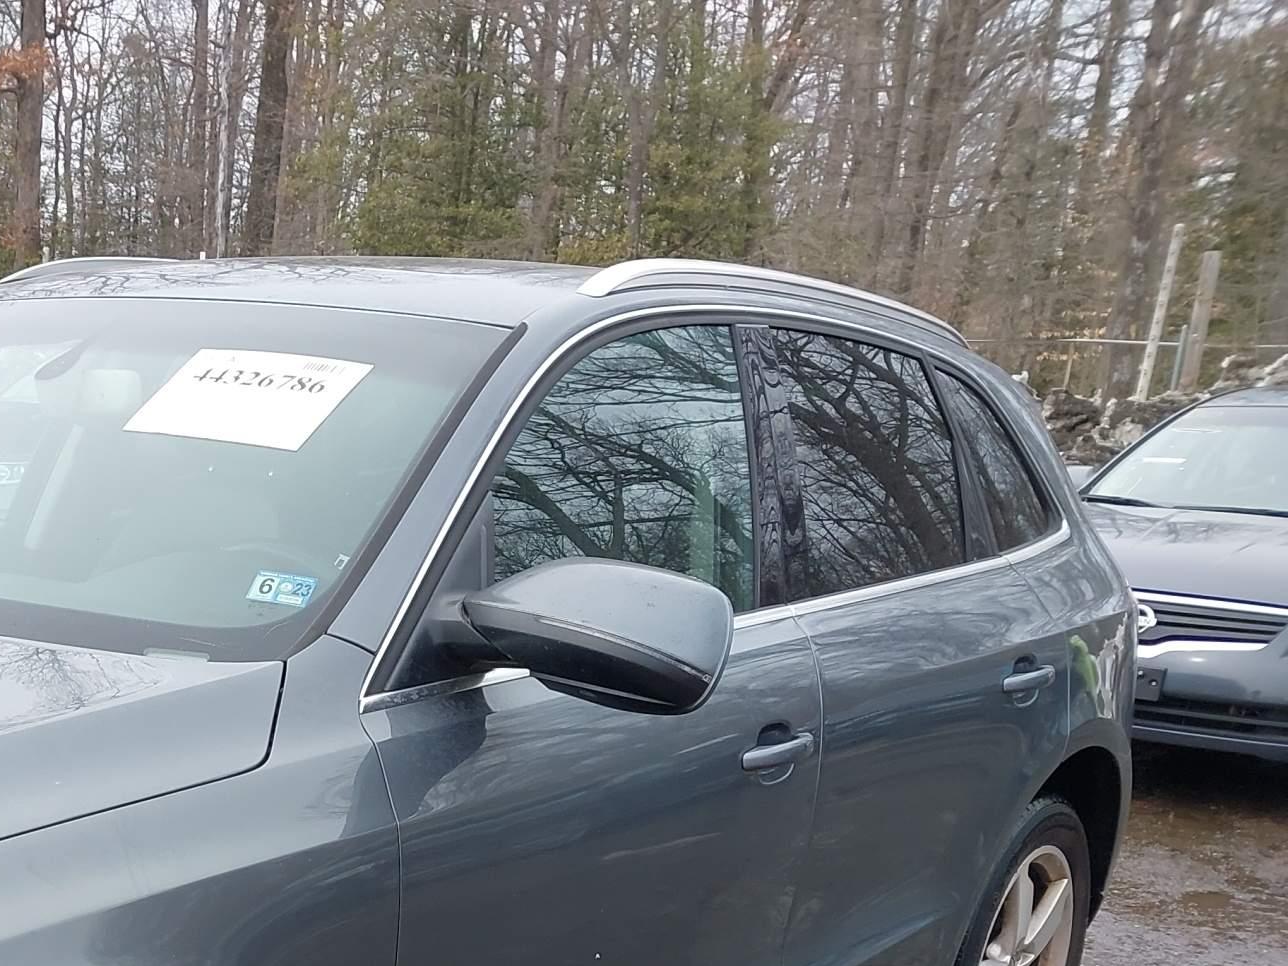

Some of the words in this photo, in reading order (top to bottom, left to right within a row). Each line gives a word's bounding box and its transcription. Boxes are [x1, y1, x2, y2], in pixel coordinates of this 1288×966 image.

[192, 367, 329, 395] 44326786
[258, 578, 275, 595] 6
[292, 583, 312, 597] 23
